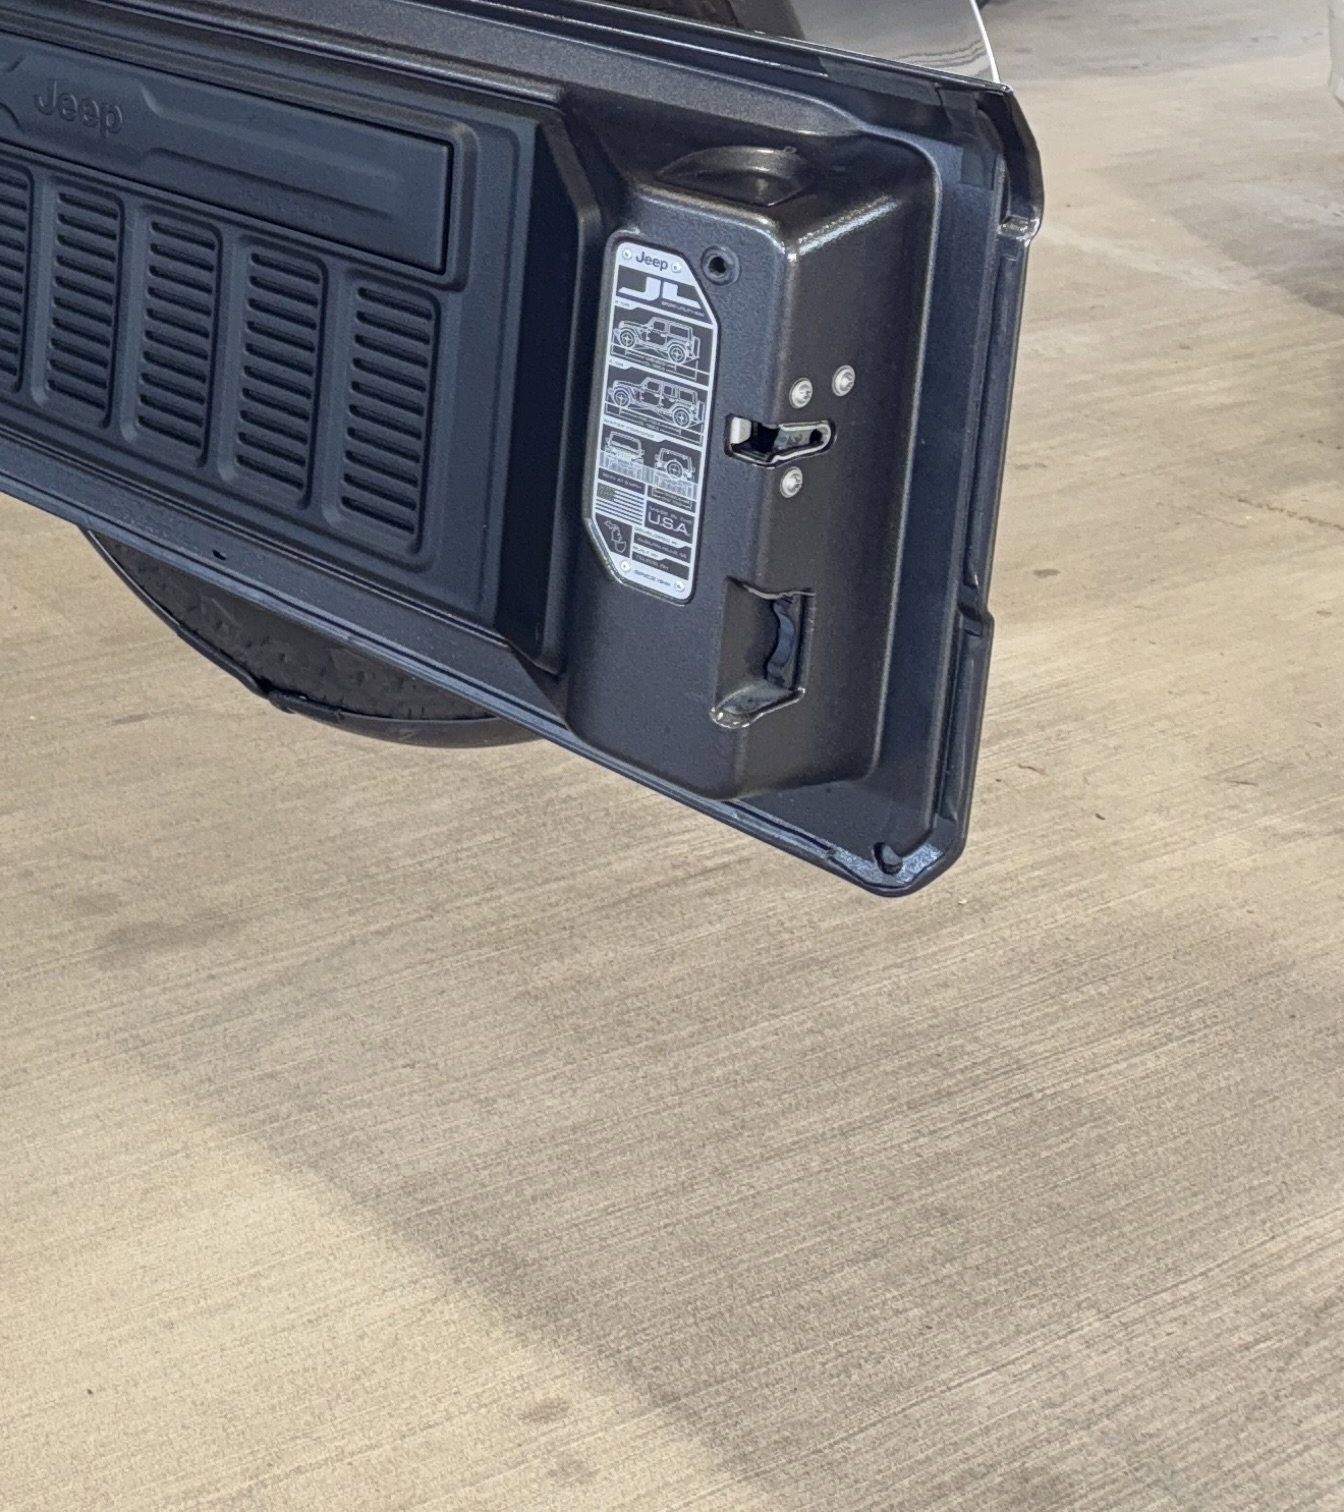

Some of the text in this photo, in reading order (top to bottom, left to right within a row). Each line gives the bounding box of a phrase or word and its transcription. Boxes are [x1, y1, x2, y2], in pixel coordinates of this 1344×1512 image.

[33, 78, 124, 138] Jeep
[635, 250, 669, 272] Jeep
[618, 277, 701, 309] JL
